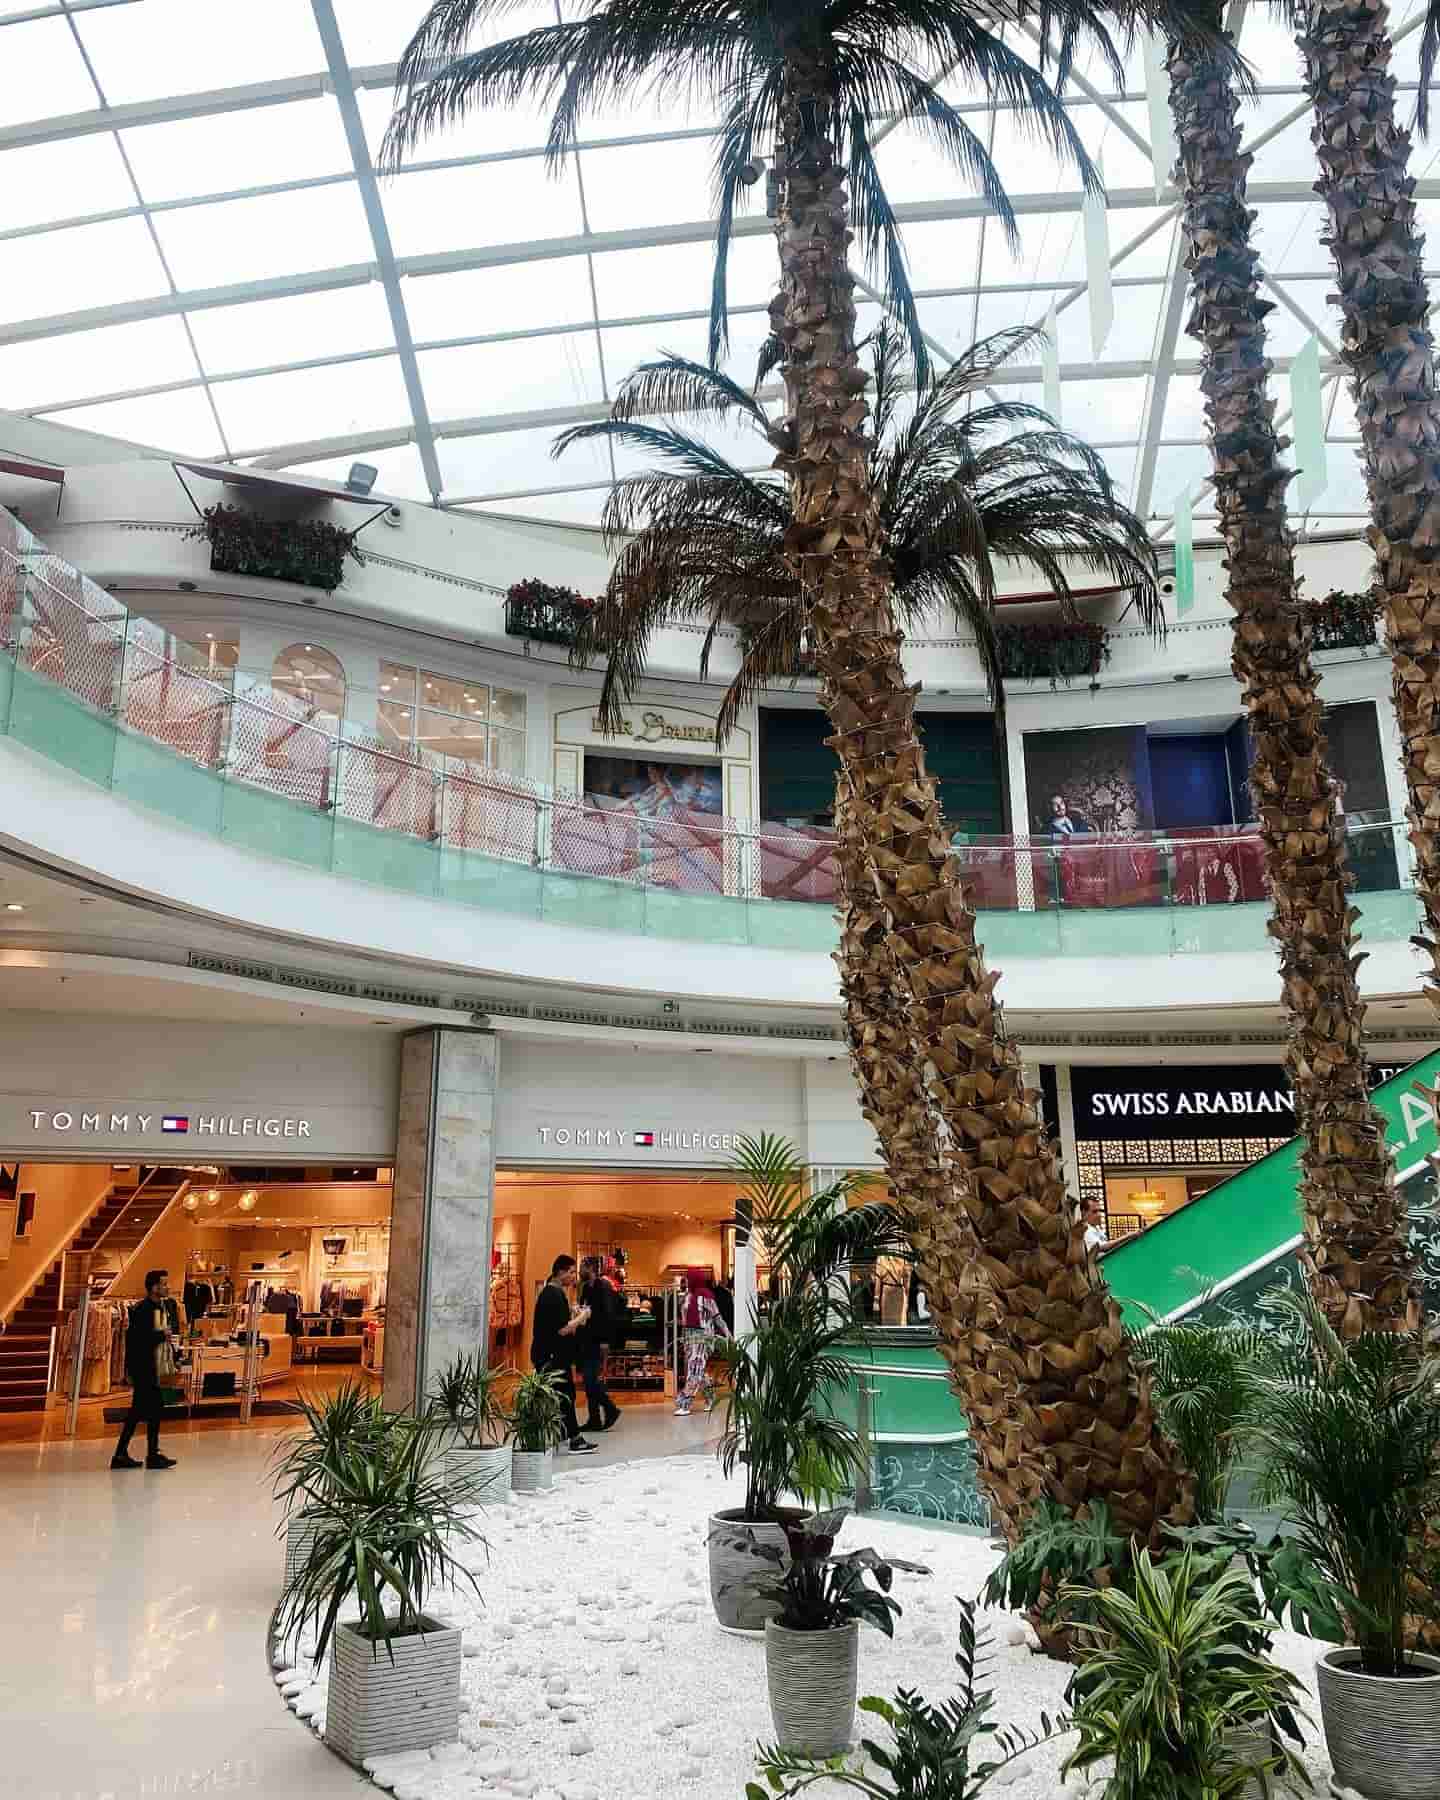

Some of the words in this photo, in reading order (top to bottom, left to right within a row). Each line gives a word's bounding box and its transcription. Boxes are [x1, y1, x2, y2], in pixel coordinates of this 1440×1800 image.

[1091, 1092, 1169, 1115] SWISS
[1174, 1090, 1296, 1114] ARABIAN
[30, 1111, 152, 1132] TOMMY
[198, 1117, 312, 1137] HILFIGER
[538, 1127, 626, 1146] TOMMY
